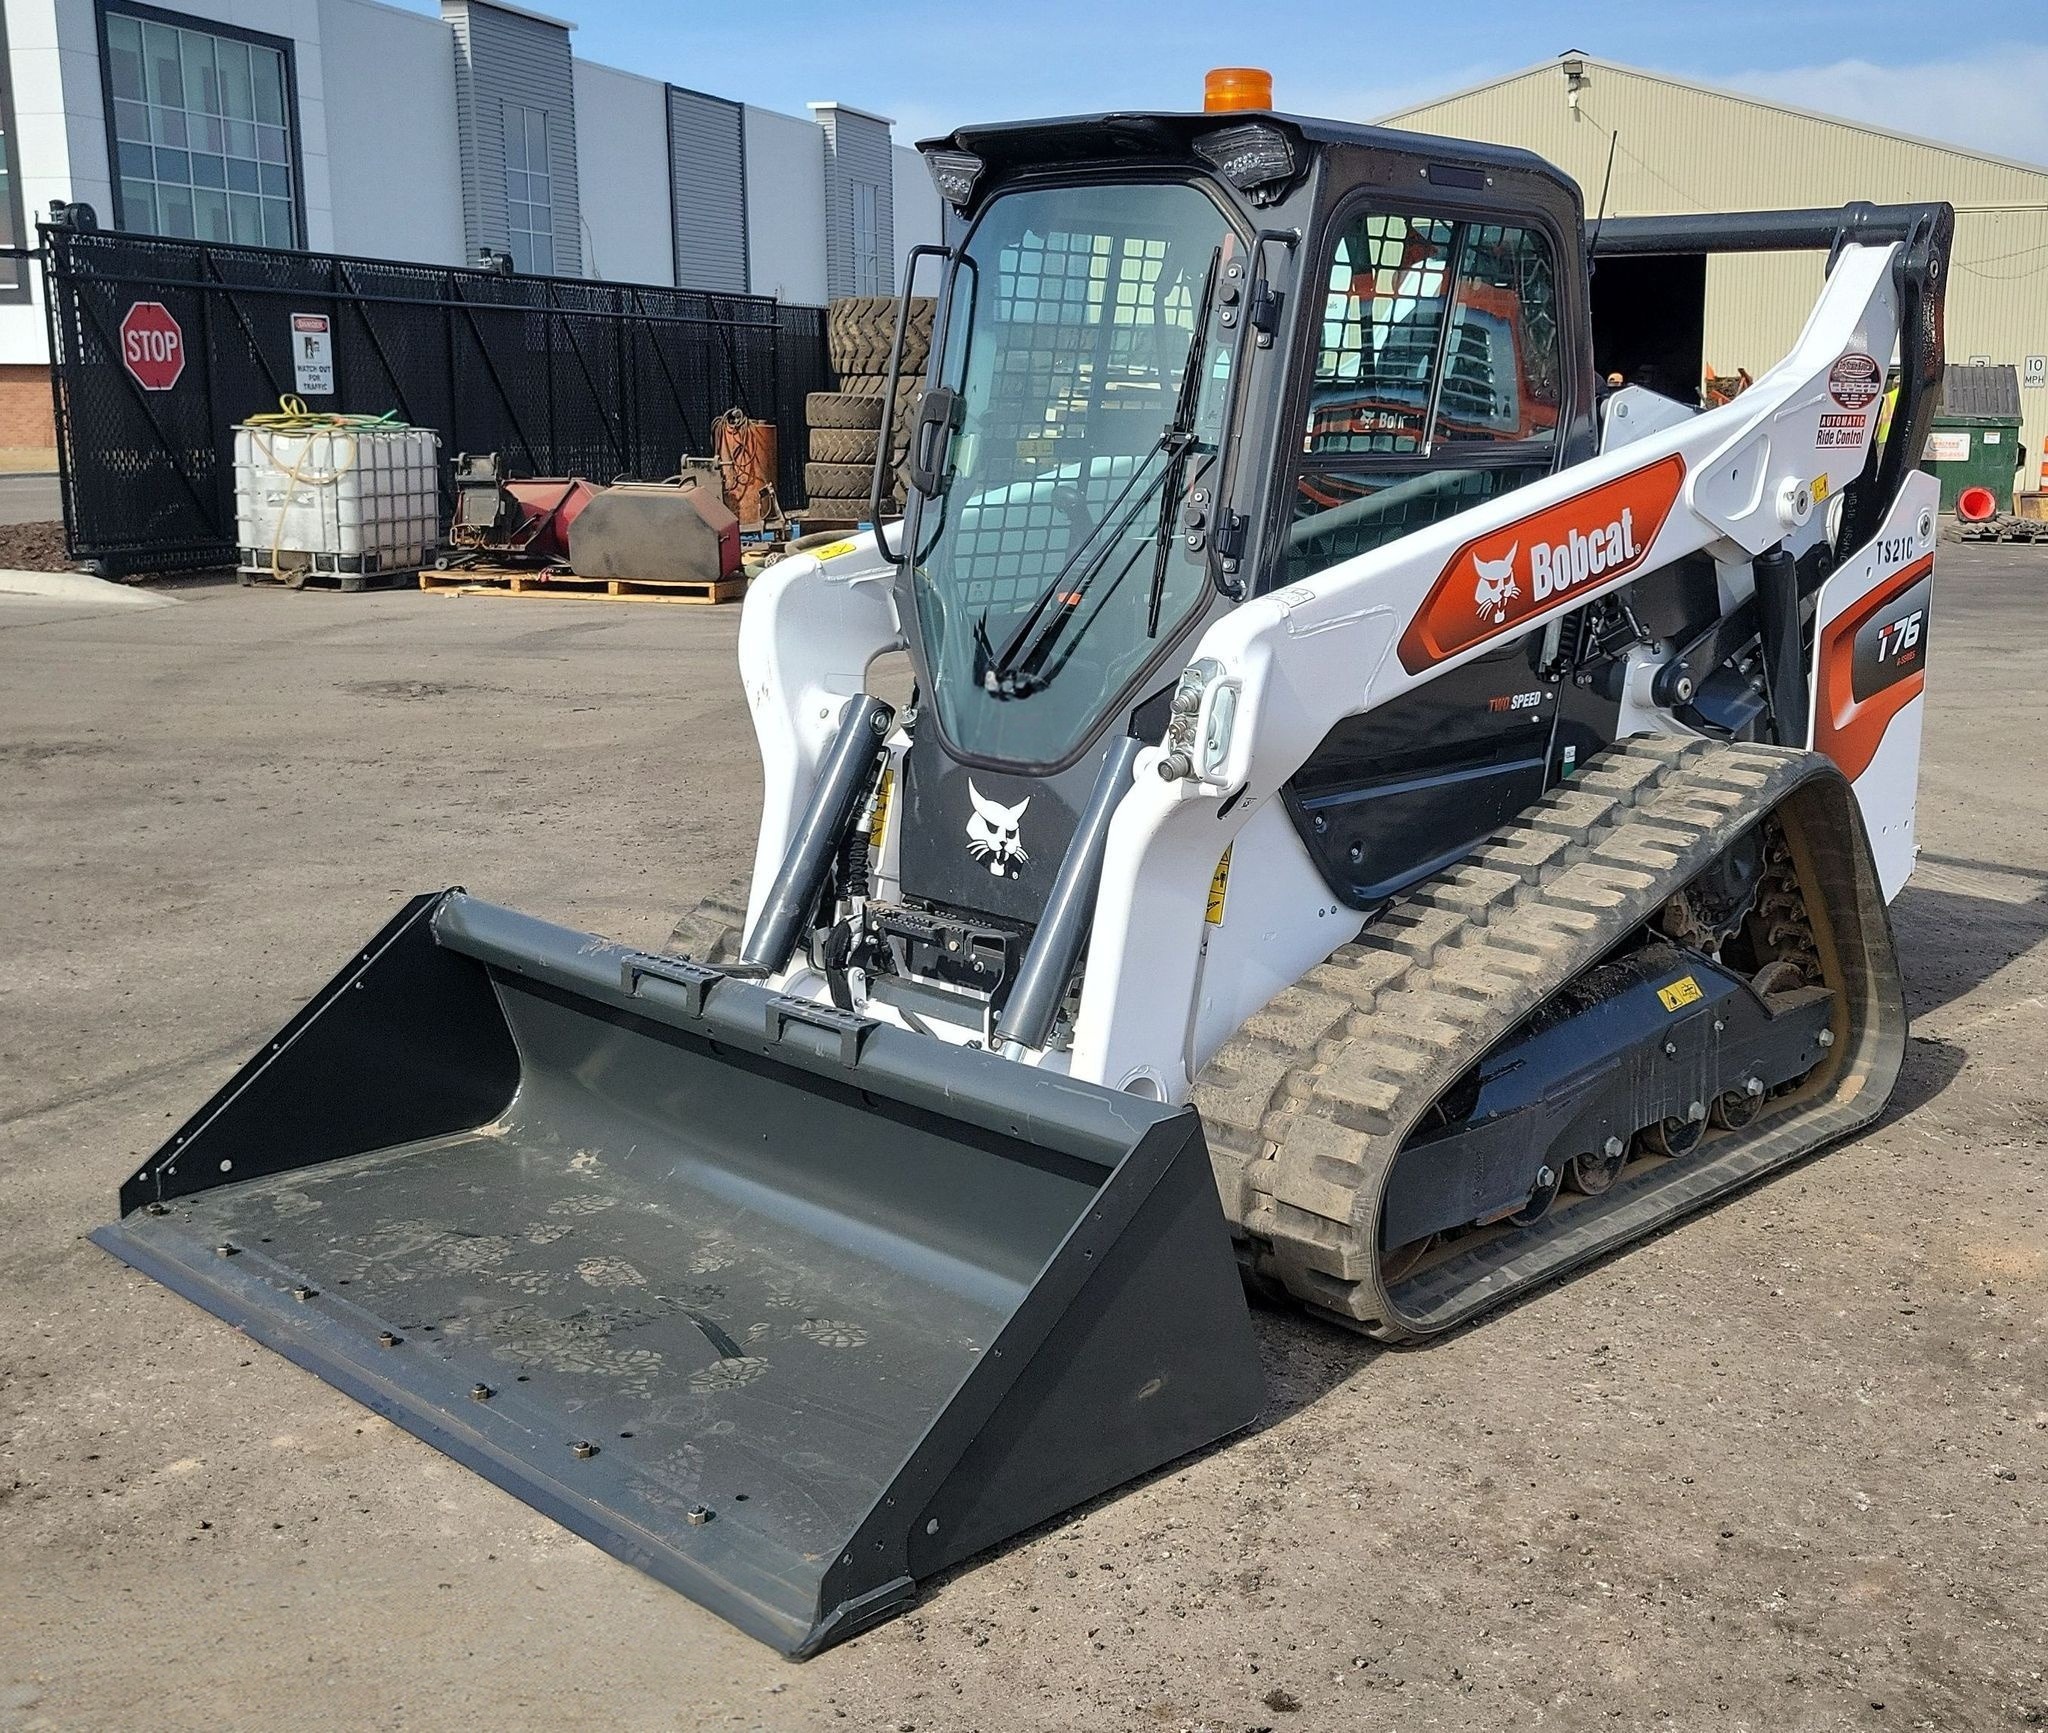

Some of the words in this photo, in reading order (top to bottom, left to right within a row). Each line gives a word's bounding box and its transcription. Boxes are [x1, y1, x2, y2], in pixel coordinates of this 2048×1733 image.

[127, 329, 178, 362] STOP
[297, 365, 317, 373] WATCH
[319, 365, 331, 374] OUT
[2028, 359, 2043, 372] 10
[308, 374, 321, 382] FOR
[2025, 375, 2044, 384] MPH
[303, 383, 328, 391] TRAFFIC
[1820, 415, 1865, 427] AUTOMATIC
[1816, 429, 1835, 446] Ride
[1835, 429, 1864, 445] Control
[1530, 507, 1634, 602] Bobcat
[1876, 536, 1914, 565] TS21C
[1878, 609, 1923, 663] T76
[1488, 697, 1511, 712] TWO
[1511, 691, 1541, 710] SPEED
